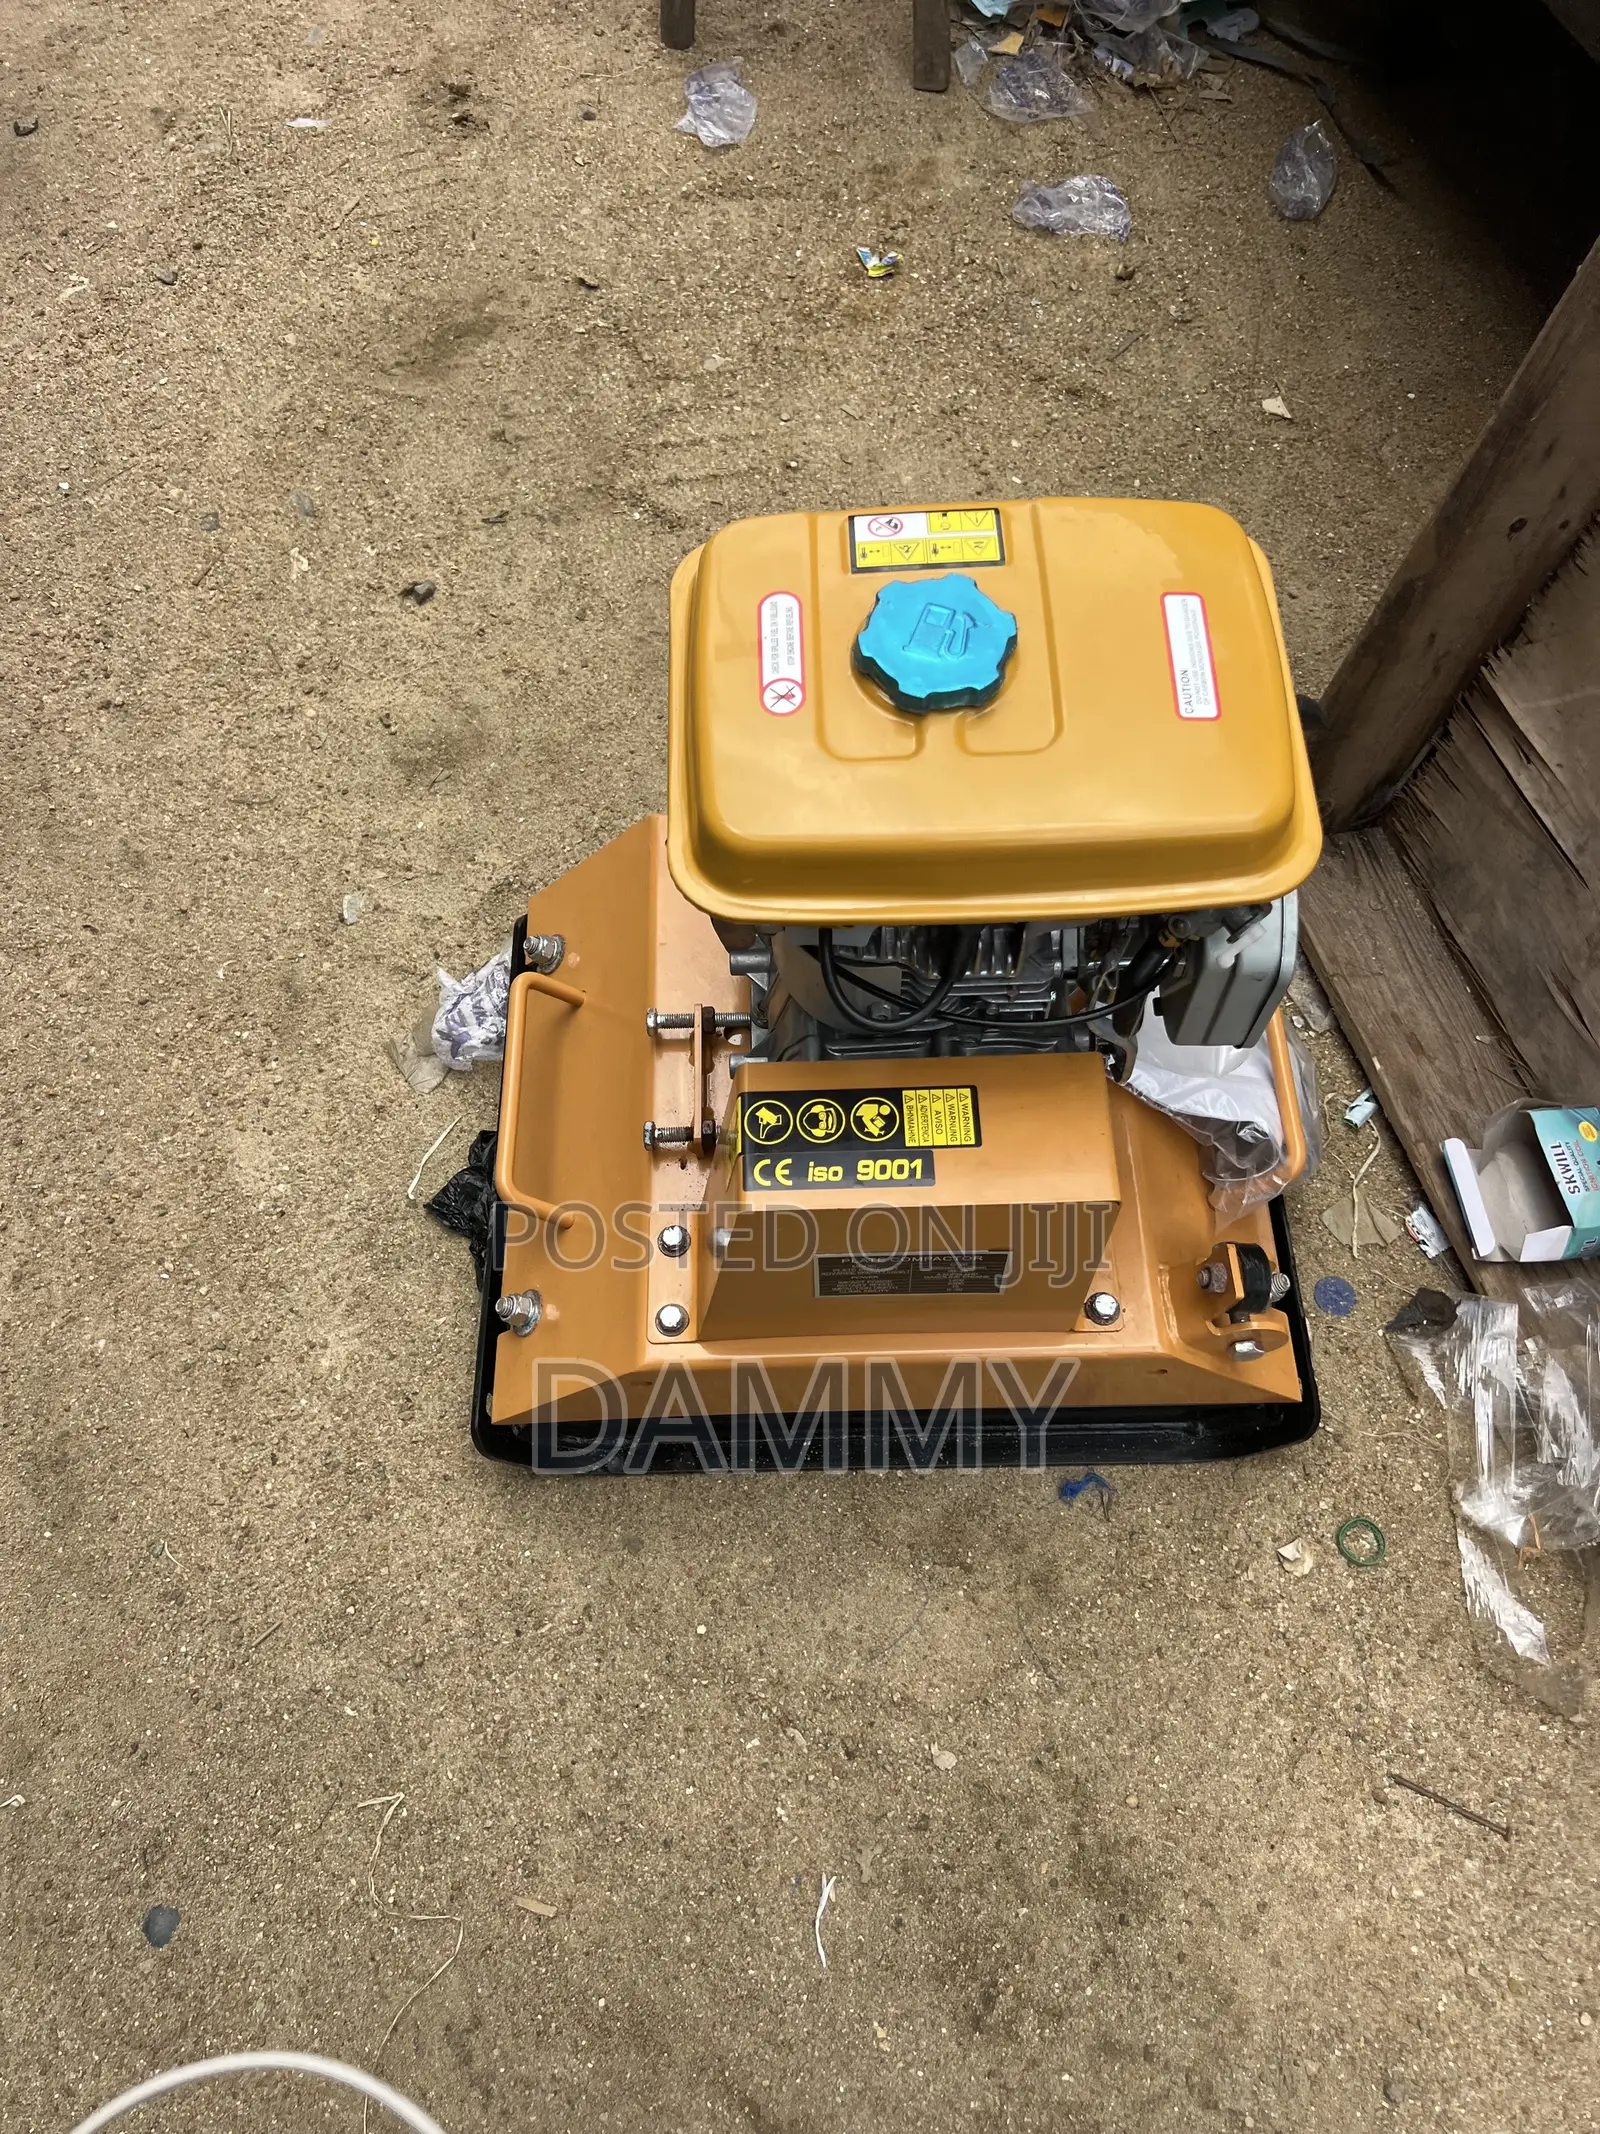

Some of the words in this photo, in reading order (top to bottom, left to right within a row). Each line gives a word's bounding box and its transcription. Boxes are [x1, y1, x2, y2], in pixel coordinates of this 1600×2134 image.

[919, 1104, 930, 1143] ADVERTENCIA
[934, 1110, 943, 1135] AVISO
[947, 1103, 958, 1142] WARNUNG
[961, 1103, 972, 1142] WARNING
[1564, 1141, 1579, 1167] QUALITY
[1573, 1140, 1584, 1157] COIL
[753, 1158, 793, 1187] CE
[807, 1161, 843, 1182] iso
[856, 1158, 922, 1181] 9001
[1550, 1142, 1581, 1195] SKWILL
[1576, 1167, 1590, 1192] SPECIAL
[1581, 1159, 1599, 1192] IGNITION
